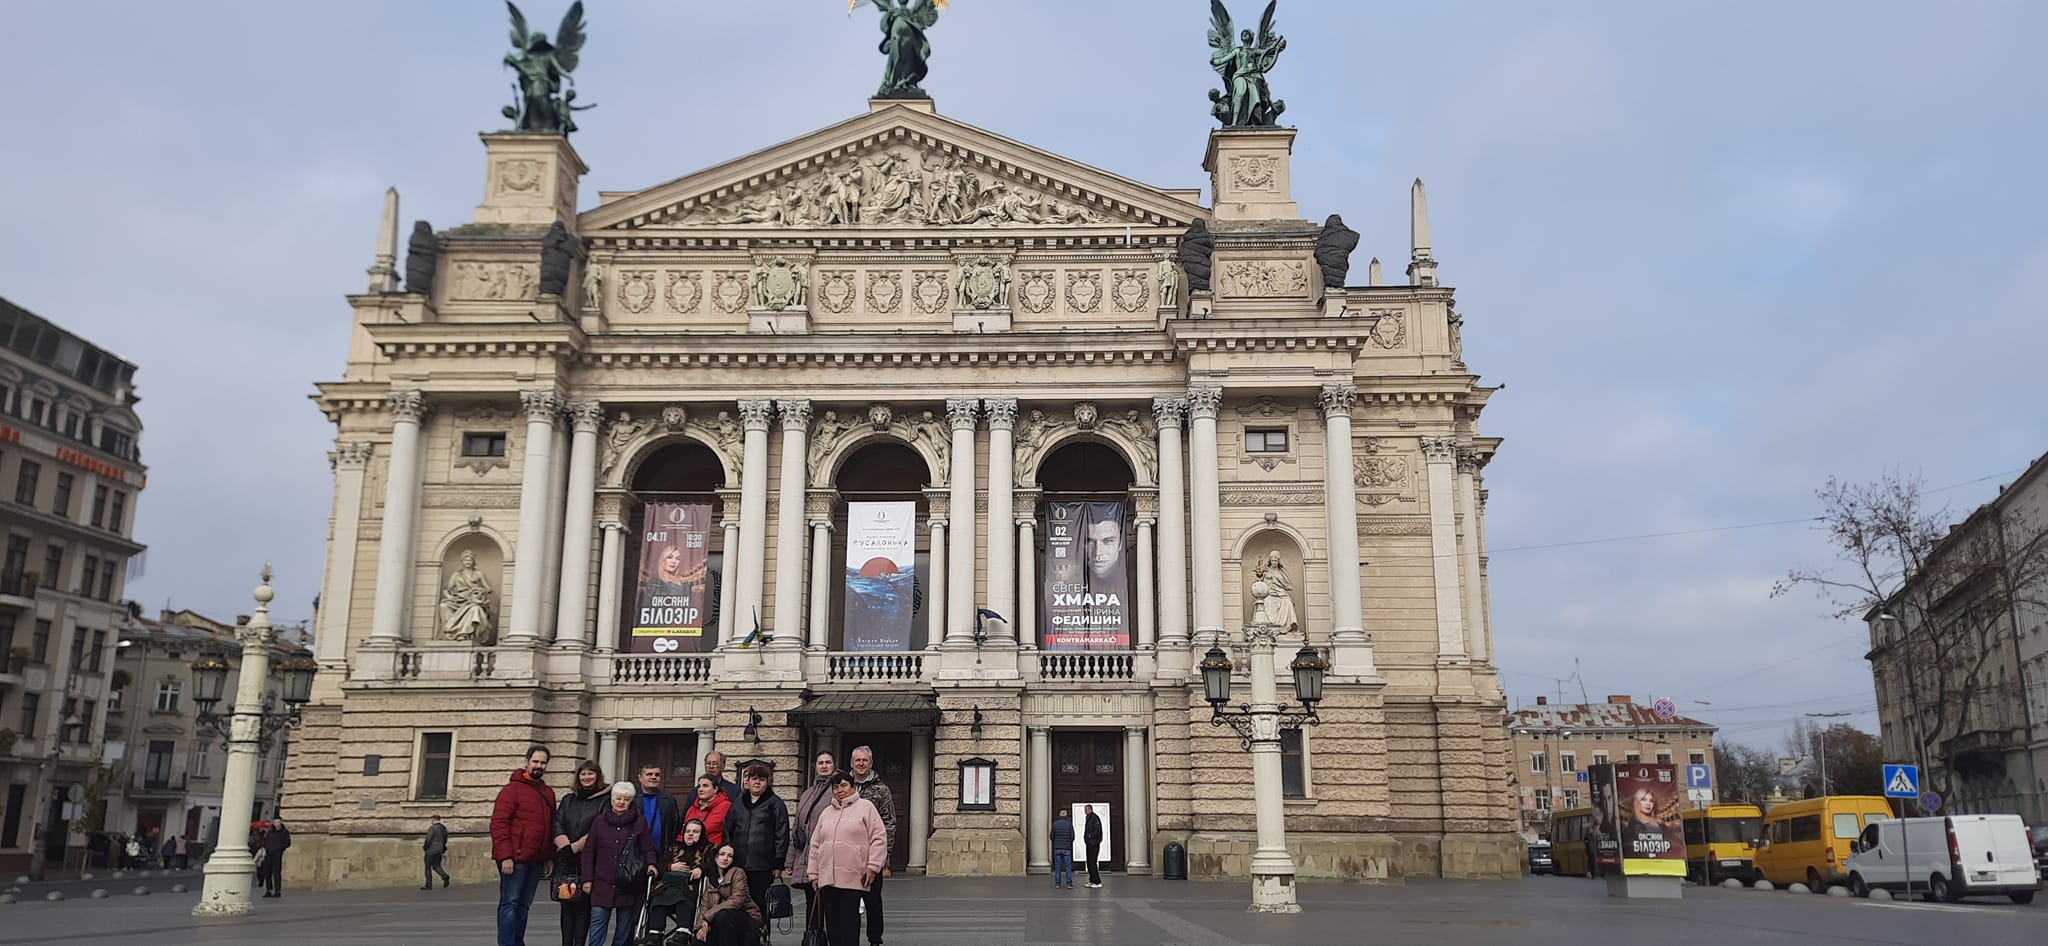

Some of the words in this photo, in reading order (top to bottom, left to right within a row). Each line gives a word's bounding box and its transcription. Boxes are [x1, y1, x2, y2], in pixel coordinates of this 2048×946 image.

[1055, 526, 1067, 536] 02
[647, 532, 667, 542] 04.11
[1052, 583, 1089, 593] ЄВГЕН
[652, 596, 689, 606] ОКСАНИ
[1053, 593, 1121, 606] ХМАРА
[640, 608, 698, 624] БІЛОЗІР
[1052, 615, 1122, 626] ФЕДИШИН
[1692, 767, 1706, 786] P
[1633, 840, 1671, 852] БІЛОЗІР
